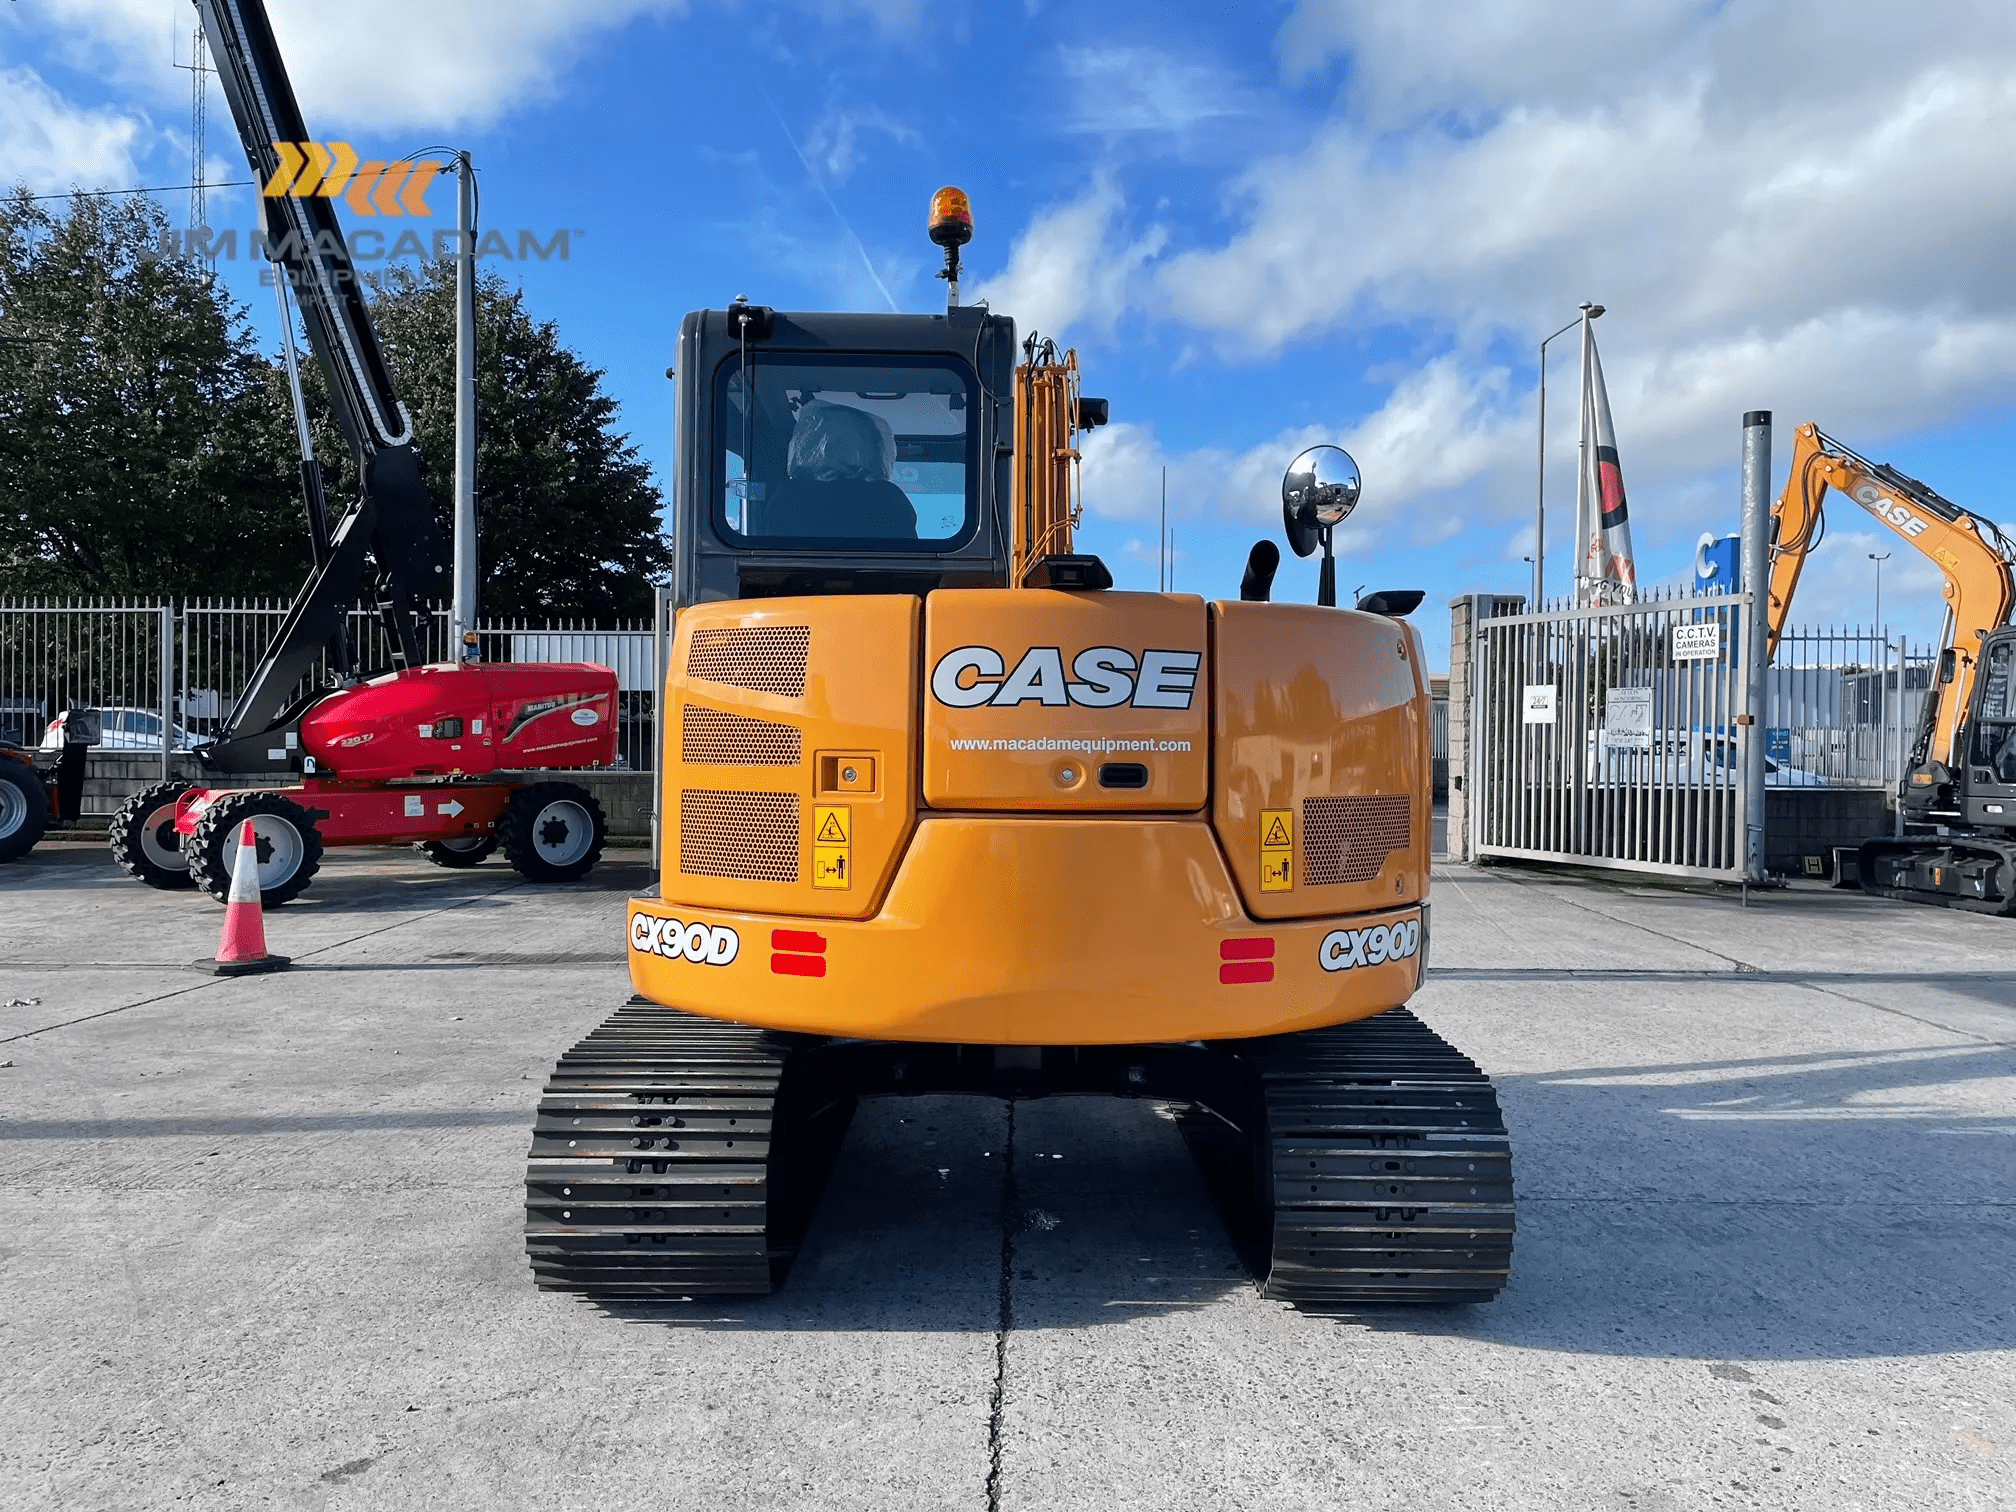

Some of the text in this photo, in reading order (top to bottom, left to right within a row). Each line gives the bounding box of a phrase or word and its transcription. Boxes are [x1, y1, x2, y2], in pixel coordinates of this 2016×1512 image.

[1856, 485, 1930, 538] CASE
[1676, 626, 1716, 640] C.C.T.V.
[1675, 639, 1716, 650] CAMERAS
[1682, 649, 1716, 657] OPERATION
[930, 645, 1203, 710] CASE
[527, 701, 556, 712] MANITOU
[950, 737, 1191, 753] www.macadamequipment.com
[630, 911, 740, 967] CX90D
[1318, 919, 1420, 973] CX90D
